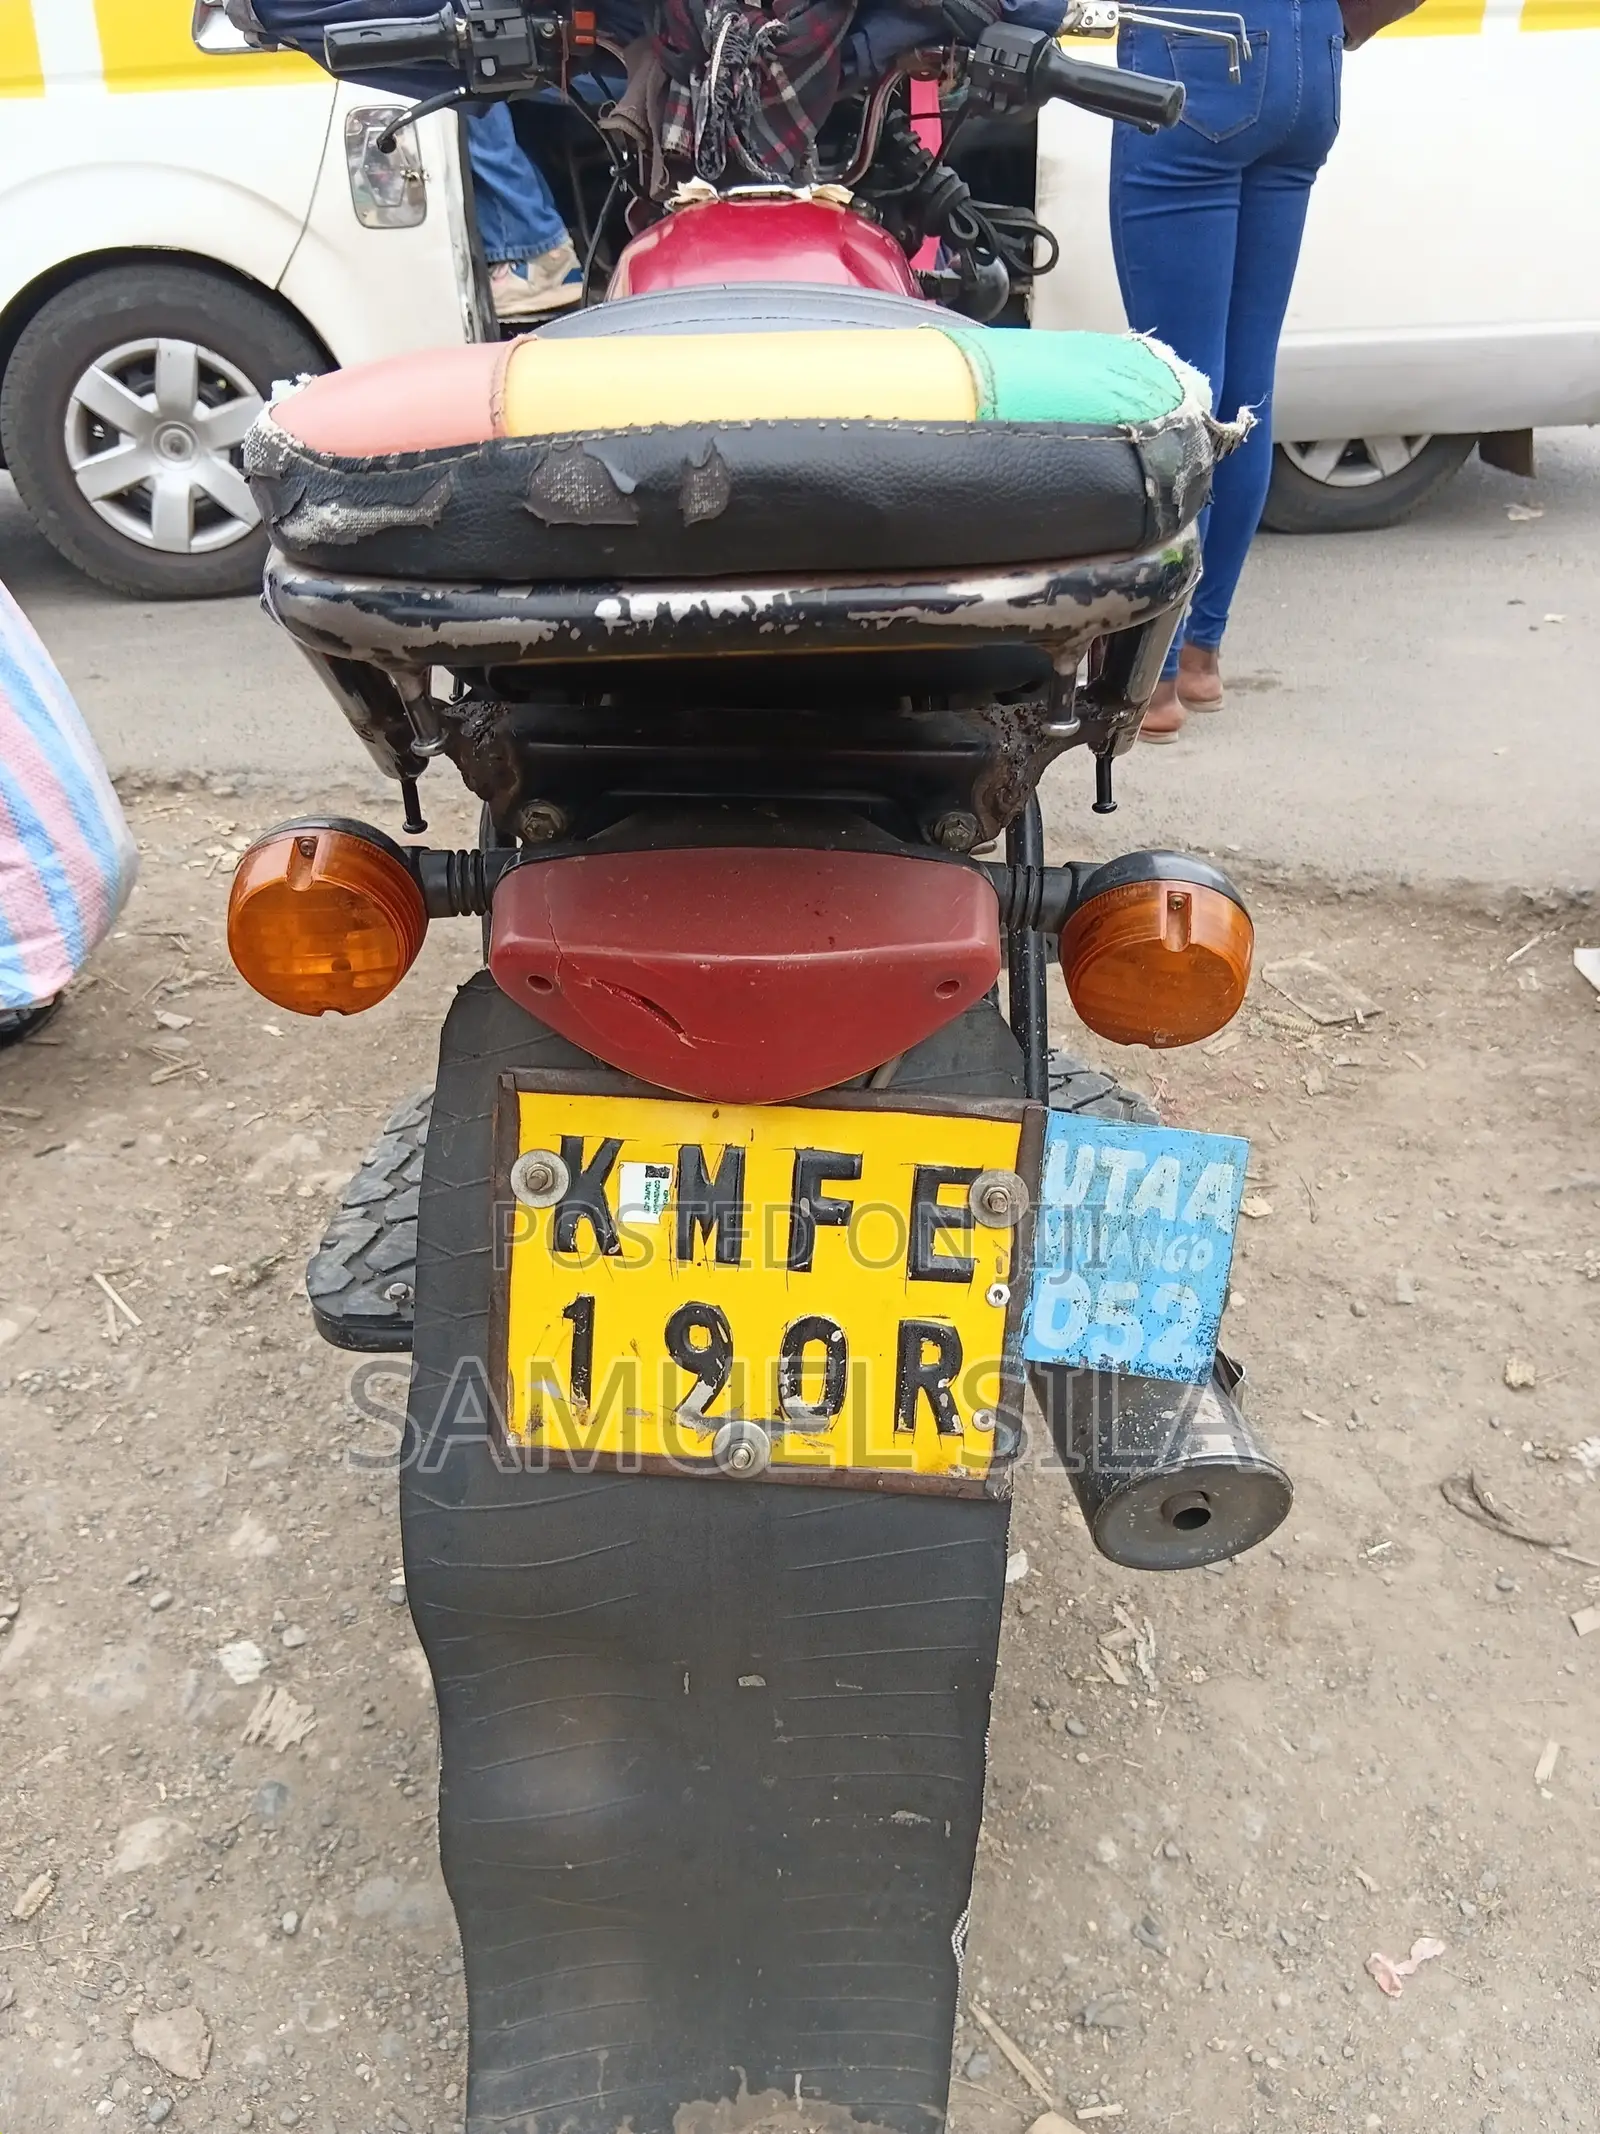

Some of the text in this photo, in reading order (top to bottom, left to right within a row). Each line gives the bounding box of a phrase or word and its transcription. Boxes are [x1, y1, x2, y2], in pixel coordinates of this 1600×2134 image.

[1044, 1138, 1235, 1234] UTAA
[562, 1290, 965, 1436] 190R
[1033, 1269, 1203, 1366] 052
